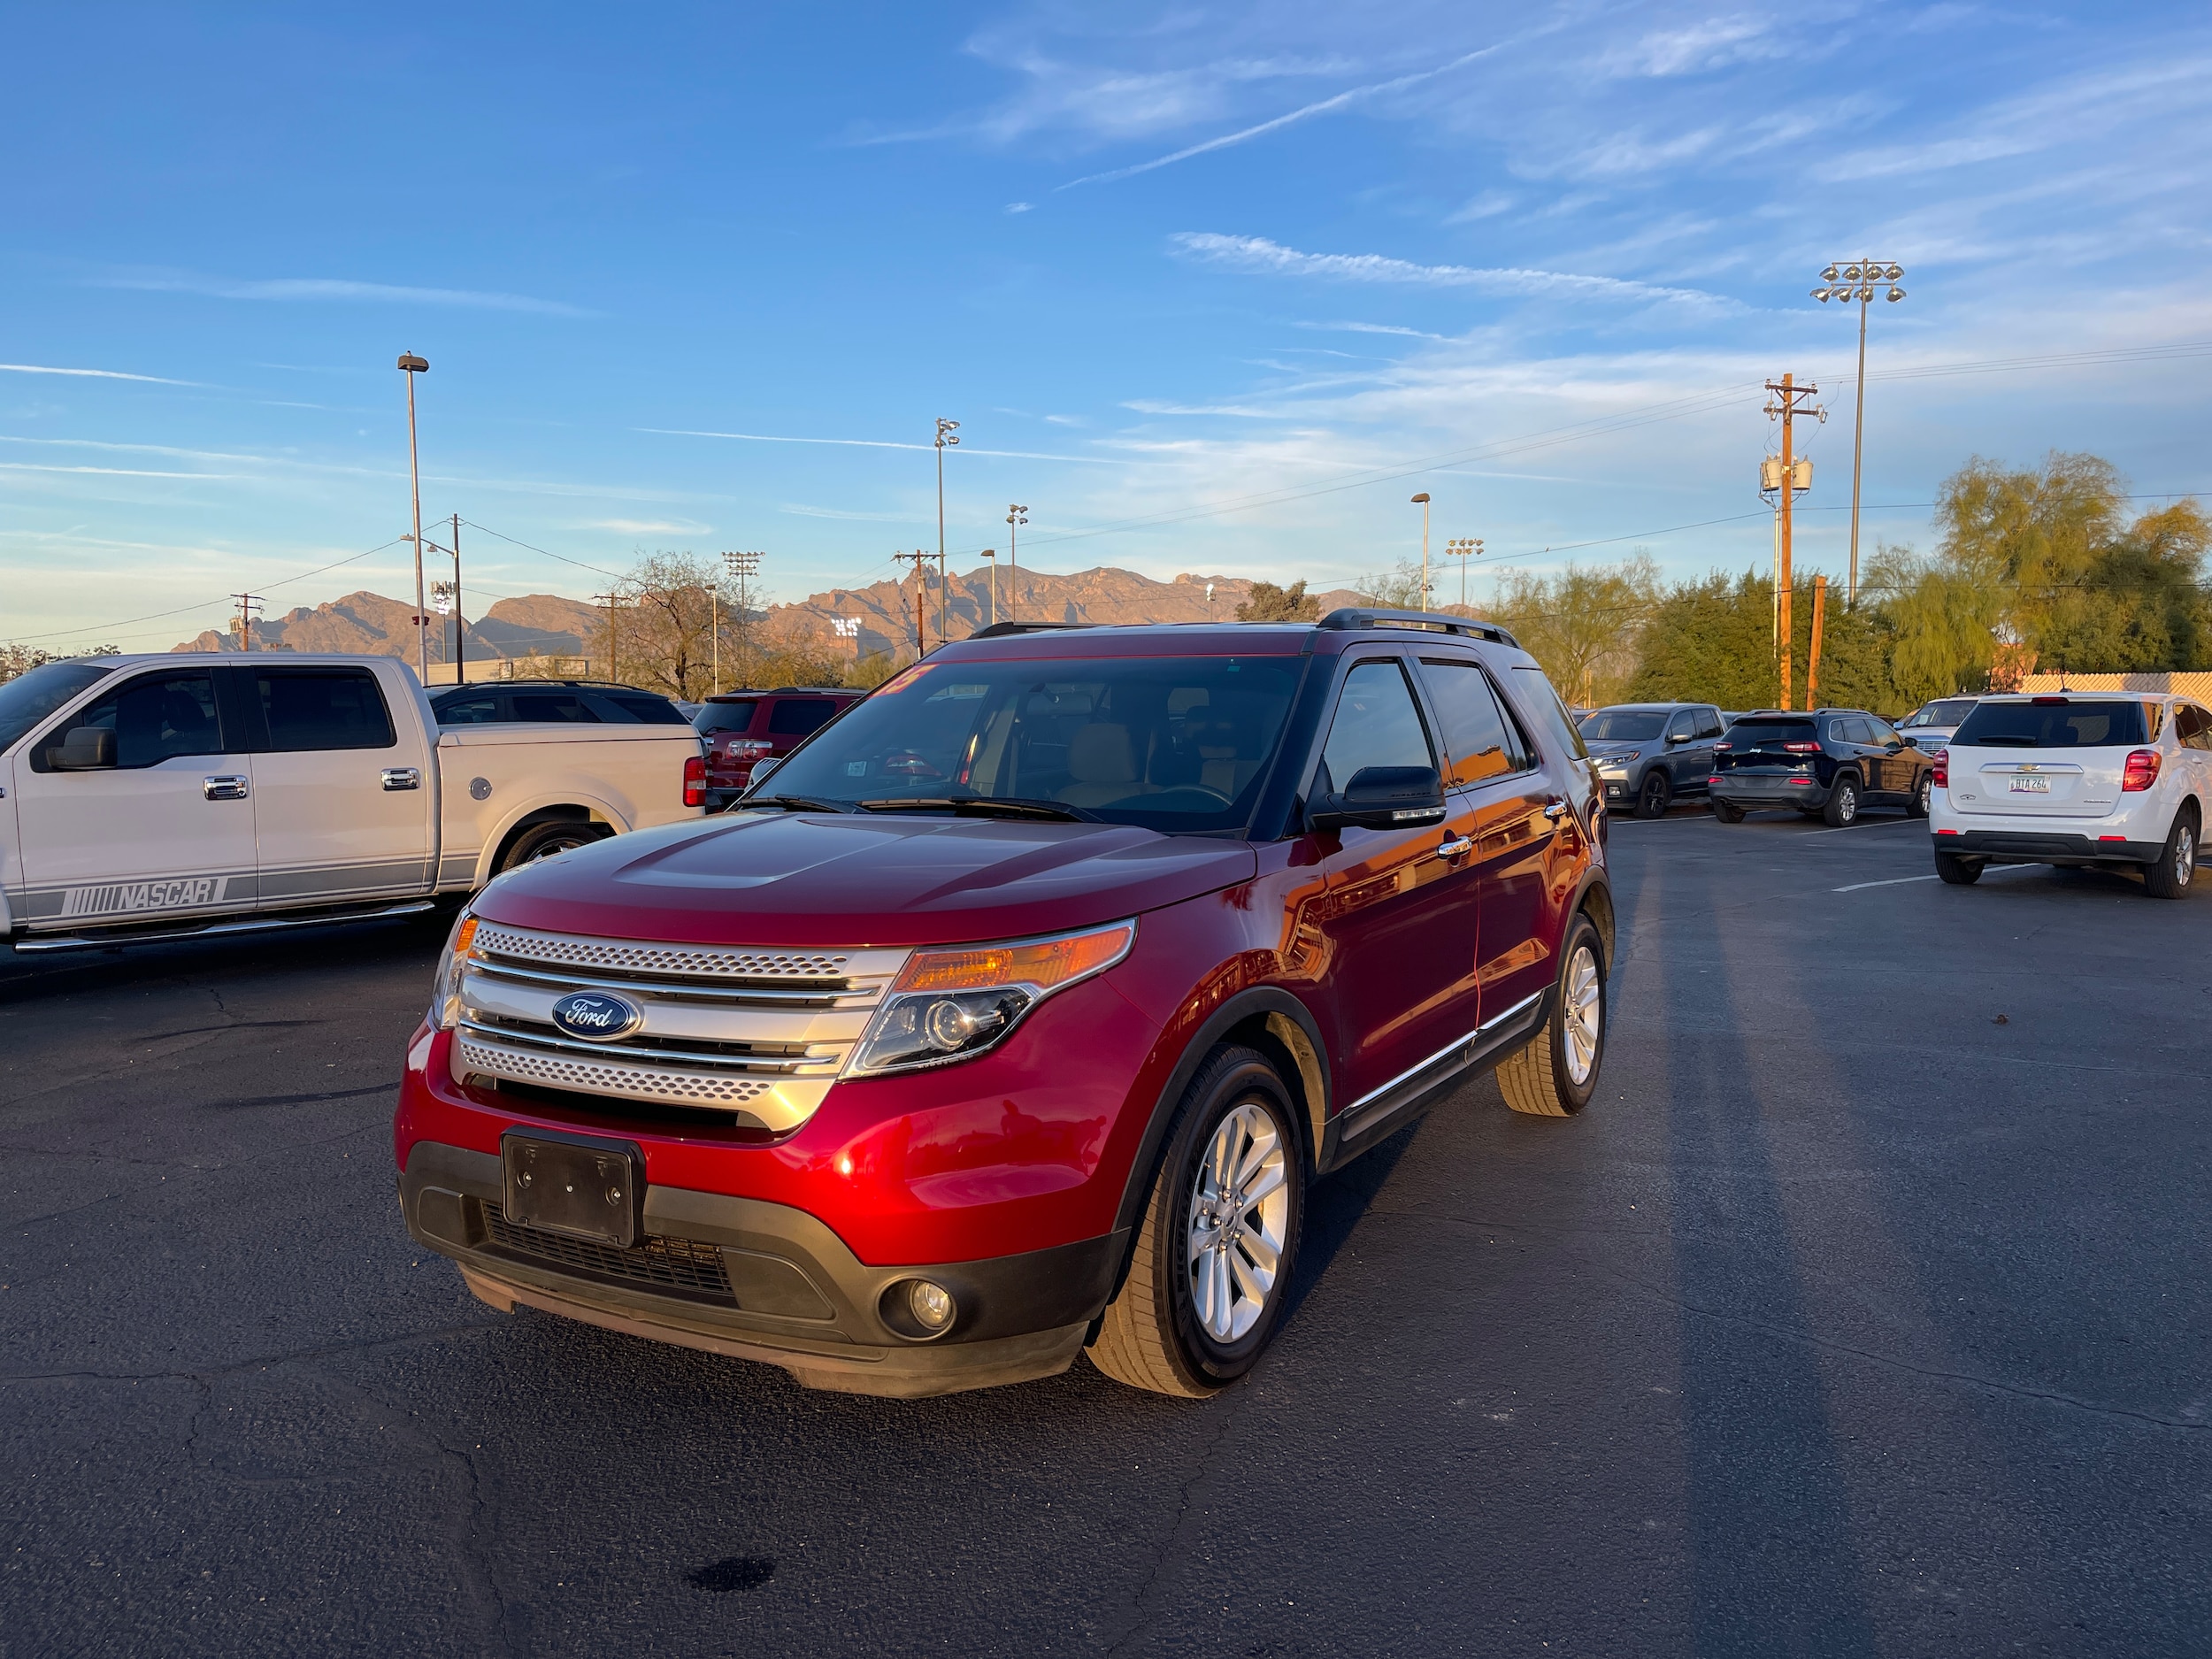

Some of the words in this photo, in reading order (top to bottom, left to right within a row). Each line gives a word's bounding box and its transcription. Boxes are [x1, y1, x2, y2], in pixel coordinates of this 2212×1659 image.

[117, 879, 212, 910] NASCAR
[565, 999, 613, 1027] Ford
[1177, 1173, 1193, 1293] MICHELIN
